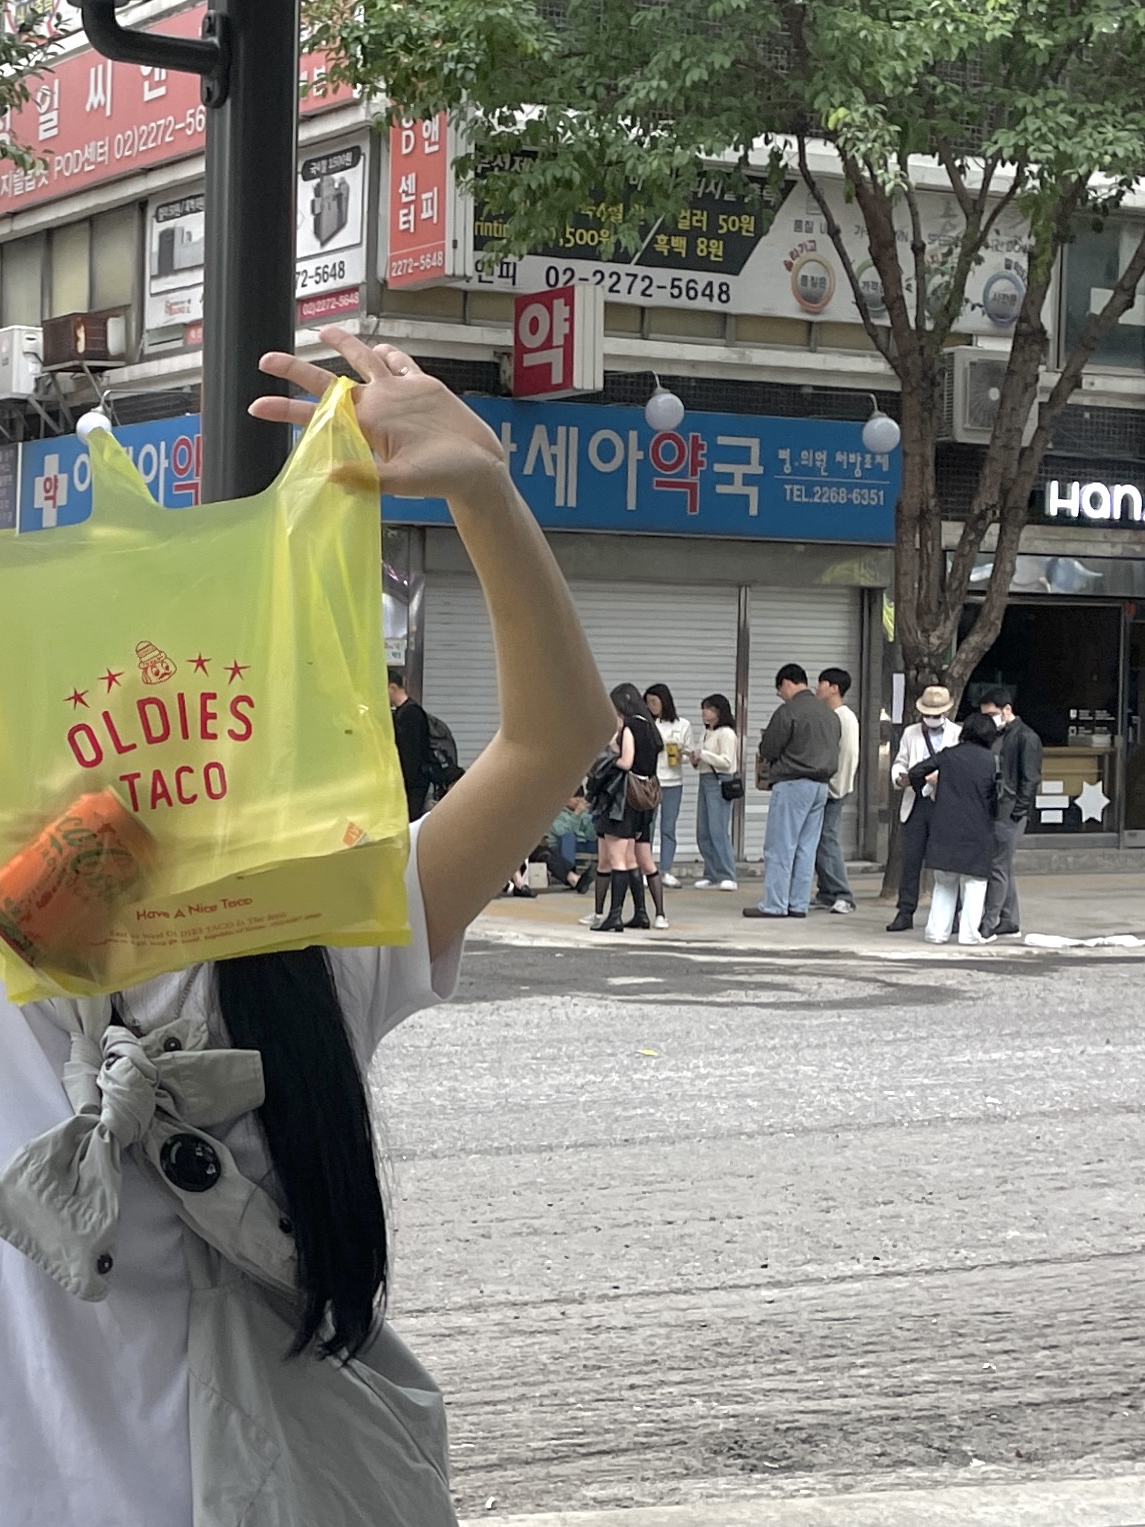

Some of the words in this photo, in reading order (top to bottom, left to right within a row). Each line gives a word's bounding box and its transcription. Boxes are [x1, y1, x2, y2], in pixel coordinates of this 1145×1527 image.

[114, 104, 205, 161] 02)2272-56
[717, 214, 755, 237] 50원
[391, 251, 444, 277] 2272-5648
[653, 234, 687, 258] 흑백
[696, 236, 724, 262] 8원
[545, 264, 732, 304] 02-2272-5648
[517, 297, 570, 385] 약
[42, 474, 59, 509] 약
[783, 484, 885, 506] TEL.2268-6351
[1049, 479, 1145, 521] Han
[67, 691, 256, 769] OLDIES
[119, 761, 228, 813] TACO
[136, 909, 170, 921] Have
[173, 907, 187, 919] A
[188, 904, 218, 915] Nice
[220, 897, 254, 909] Taco
